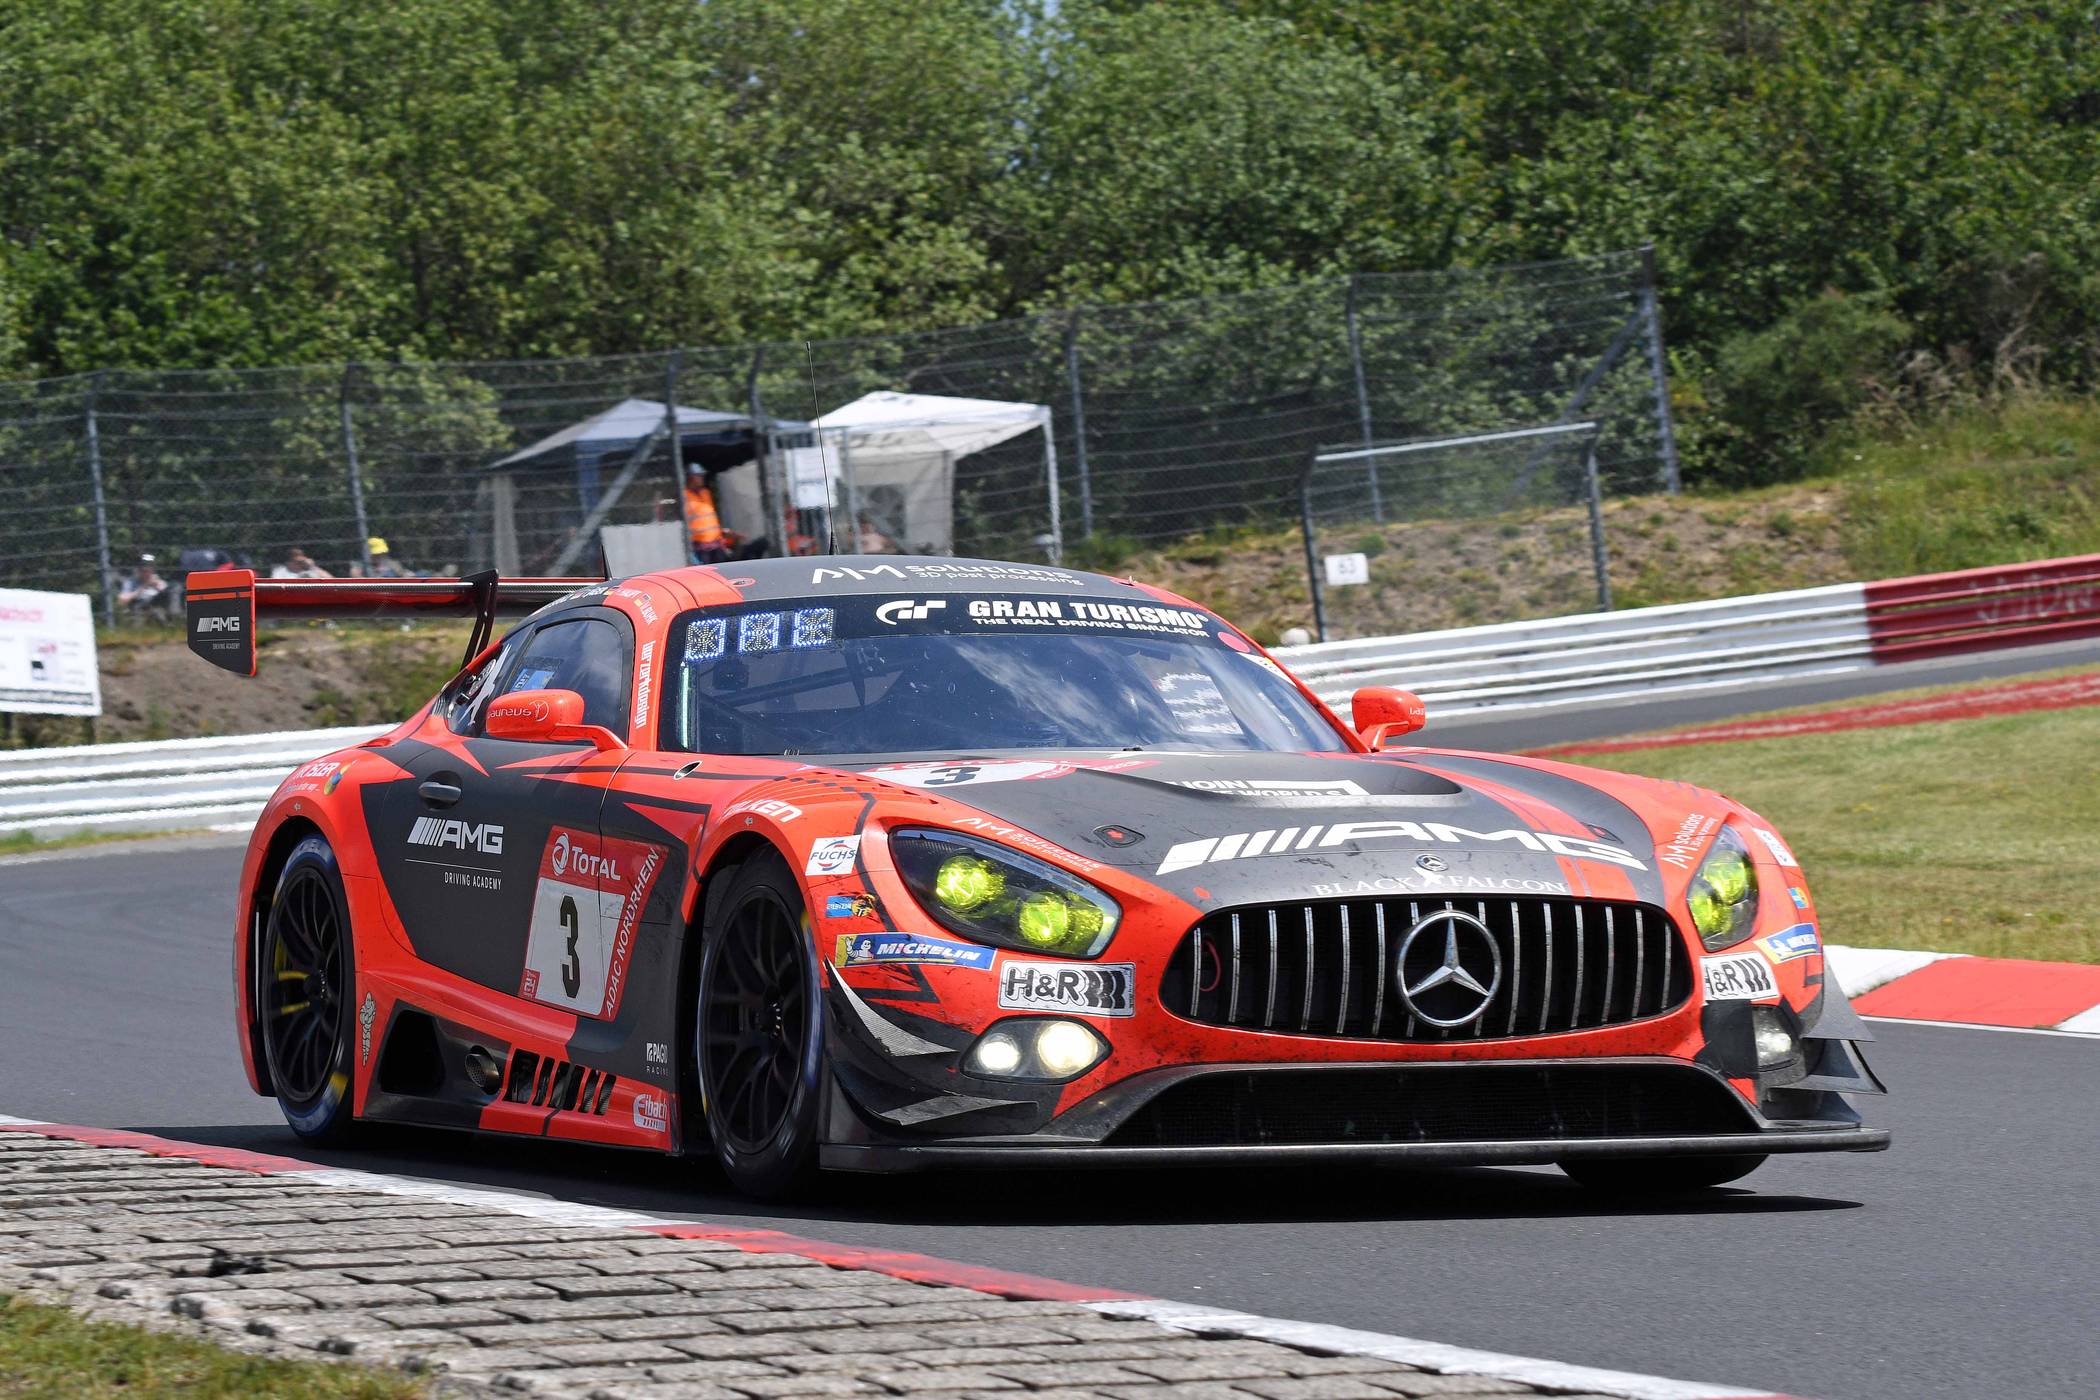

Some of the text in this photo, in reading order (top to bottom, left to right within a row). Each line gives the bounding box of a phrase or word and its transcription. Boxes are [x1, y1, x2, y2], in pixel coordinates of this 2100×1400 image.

[969, 600, 1062, 618] GRAN
[210, 616, 240, 631] AMG
[1011, 618, 1052, 626] REAL
[1056, 619, 1124, 630] DRIVING
[1126, 623, 1210, 637] SIMULATOR
[924, 767, 981, 784] 3
[437, 819, 504, 854] AMG
[1319, 821, 1648, 870] AMG
[571, 846, 621, 881] TOTAL
[811, 849, 856, 860] FUCHS
[444, 871, 501, 890] DRIVING ACADEMY
[1313, 875, 1568, 896] BLACK FALCON
[606, 847, 660, 1017] ADAC NORDRHEIN
[560, 893, 581, 999] 3
[877, 942, 981, 961] MICHELIN
[1005, 967, 1085, 1005] H&R
[633, 1093, 668, 1121] Eibach
